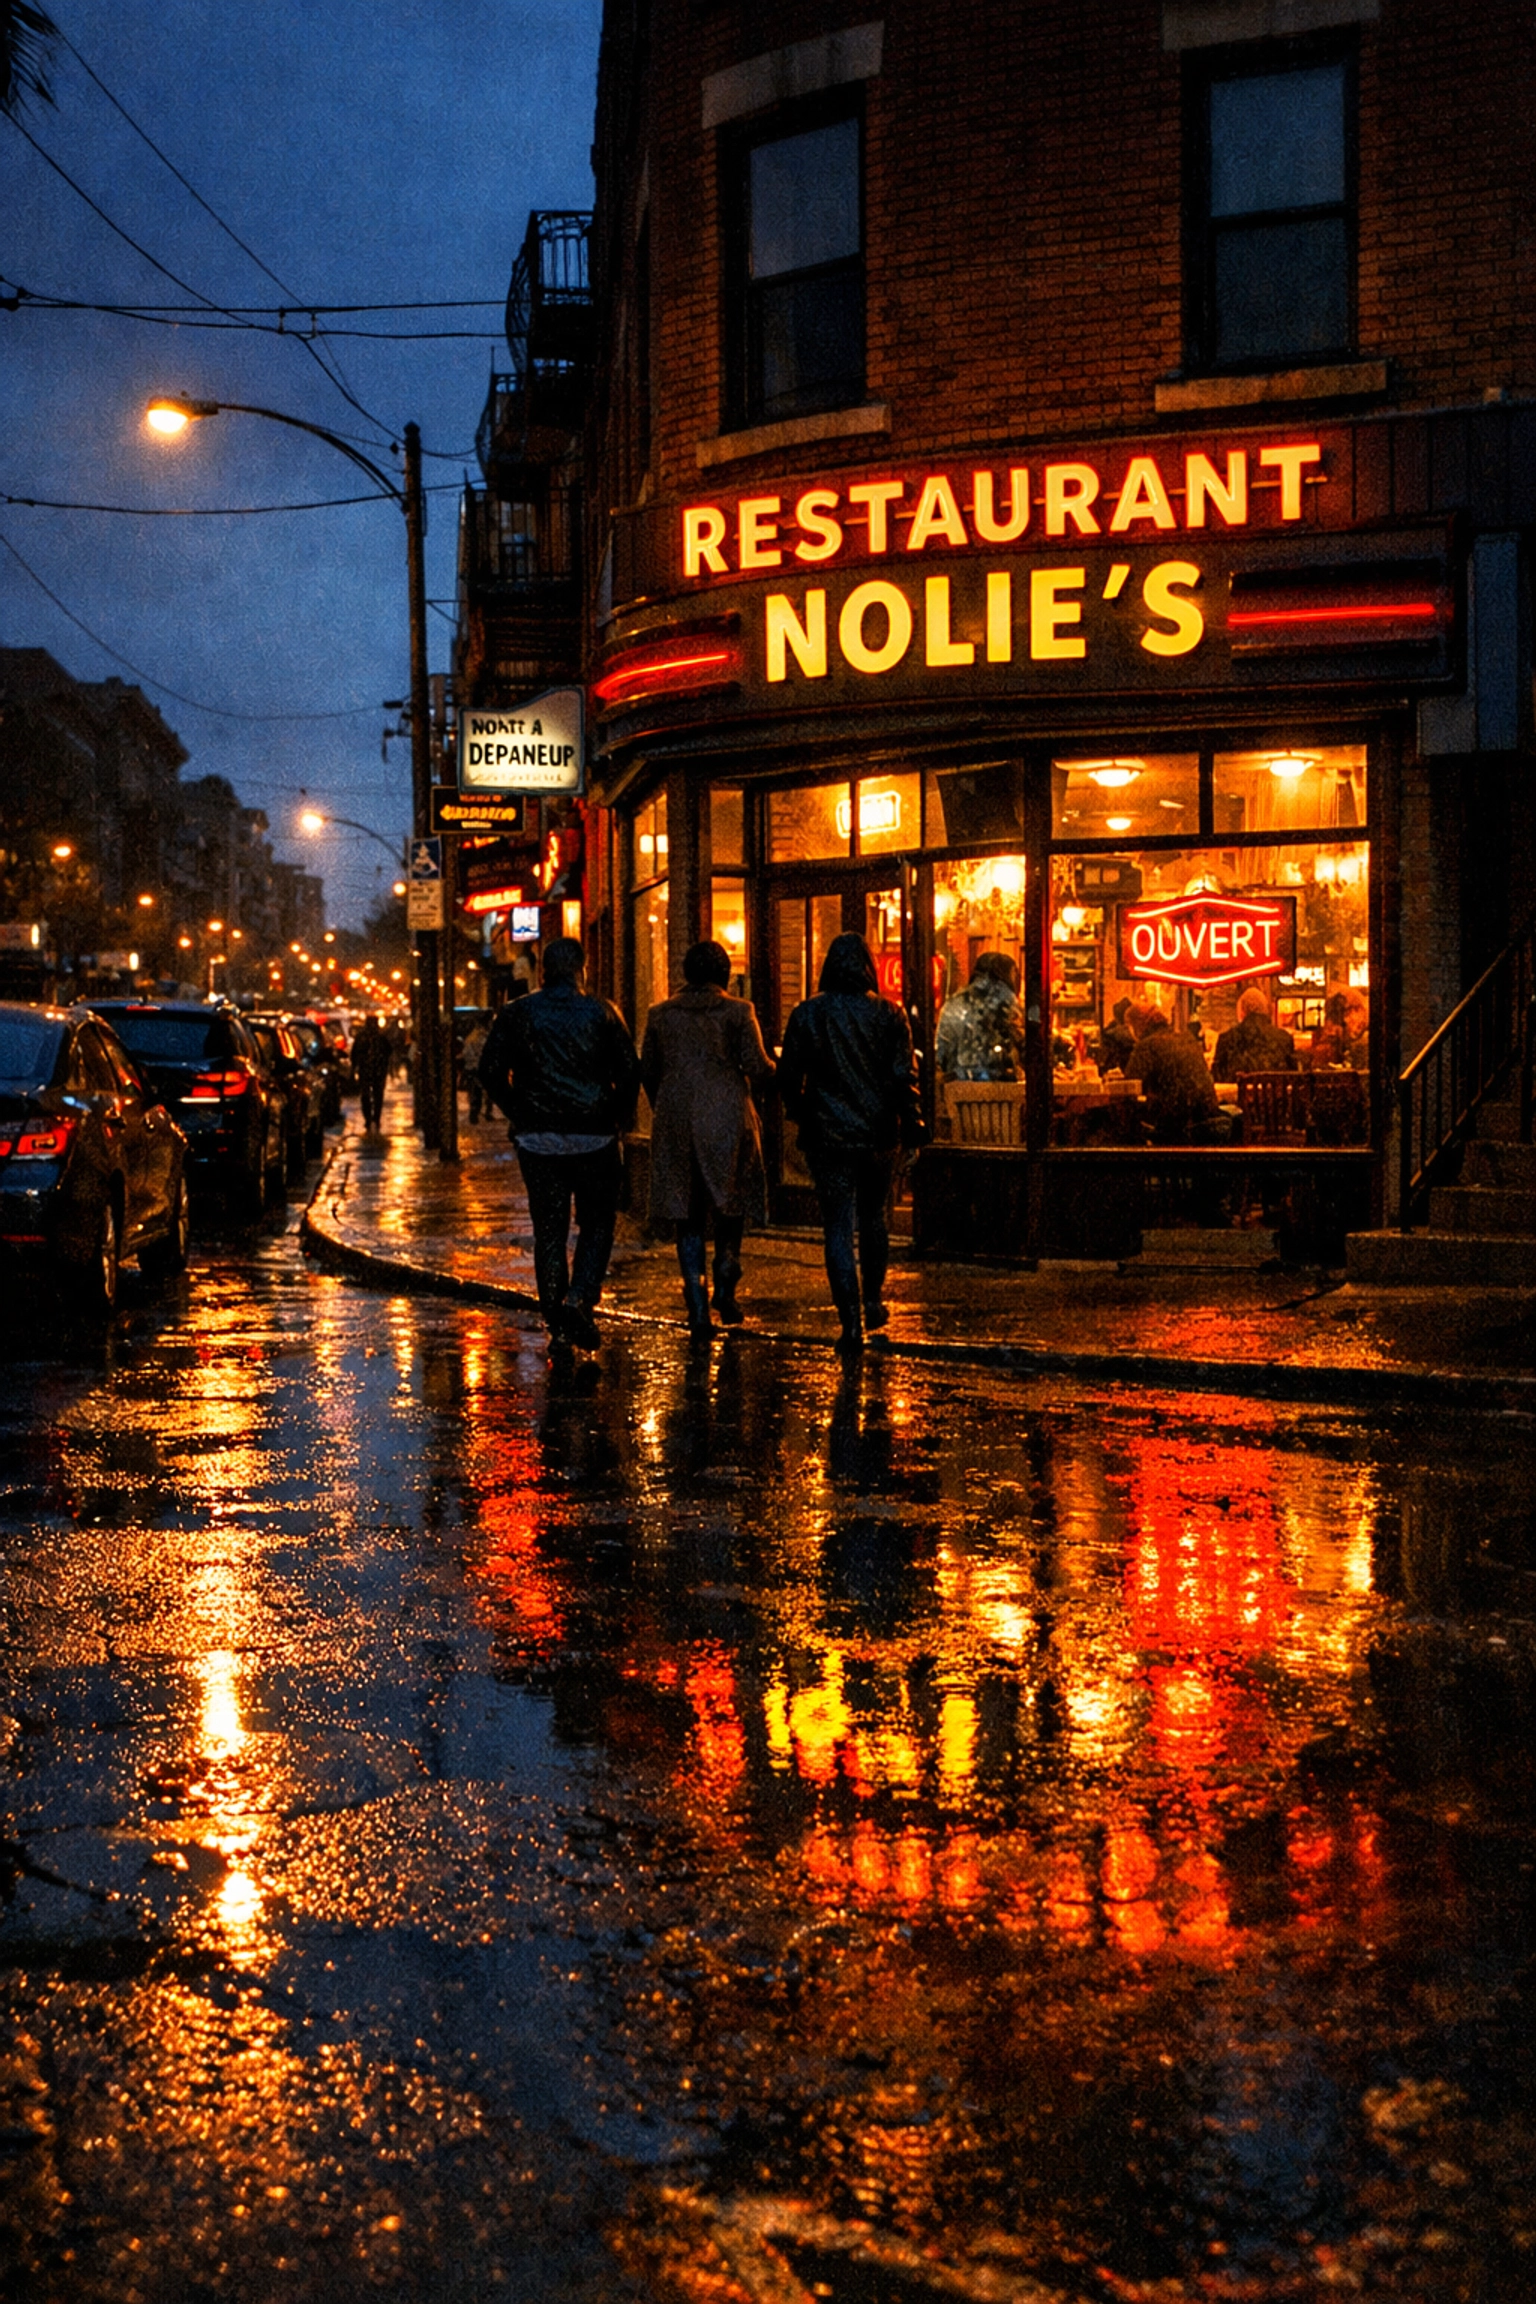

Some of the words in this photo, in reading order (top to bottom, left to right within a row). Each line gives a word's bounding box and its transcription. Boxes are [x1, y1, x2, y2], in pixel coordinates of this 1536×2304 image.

[682, 443, 1322, 578] RESTAURANT
[764, 560, 1206, 683] NOLIE'S
[469, 743, 575, 767] DEPANEUP
[1131, 919, 1282, 962] OUVERT
